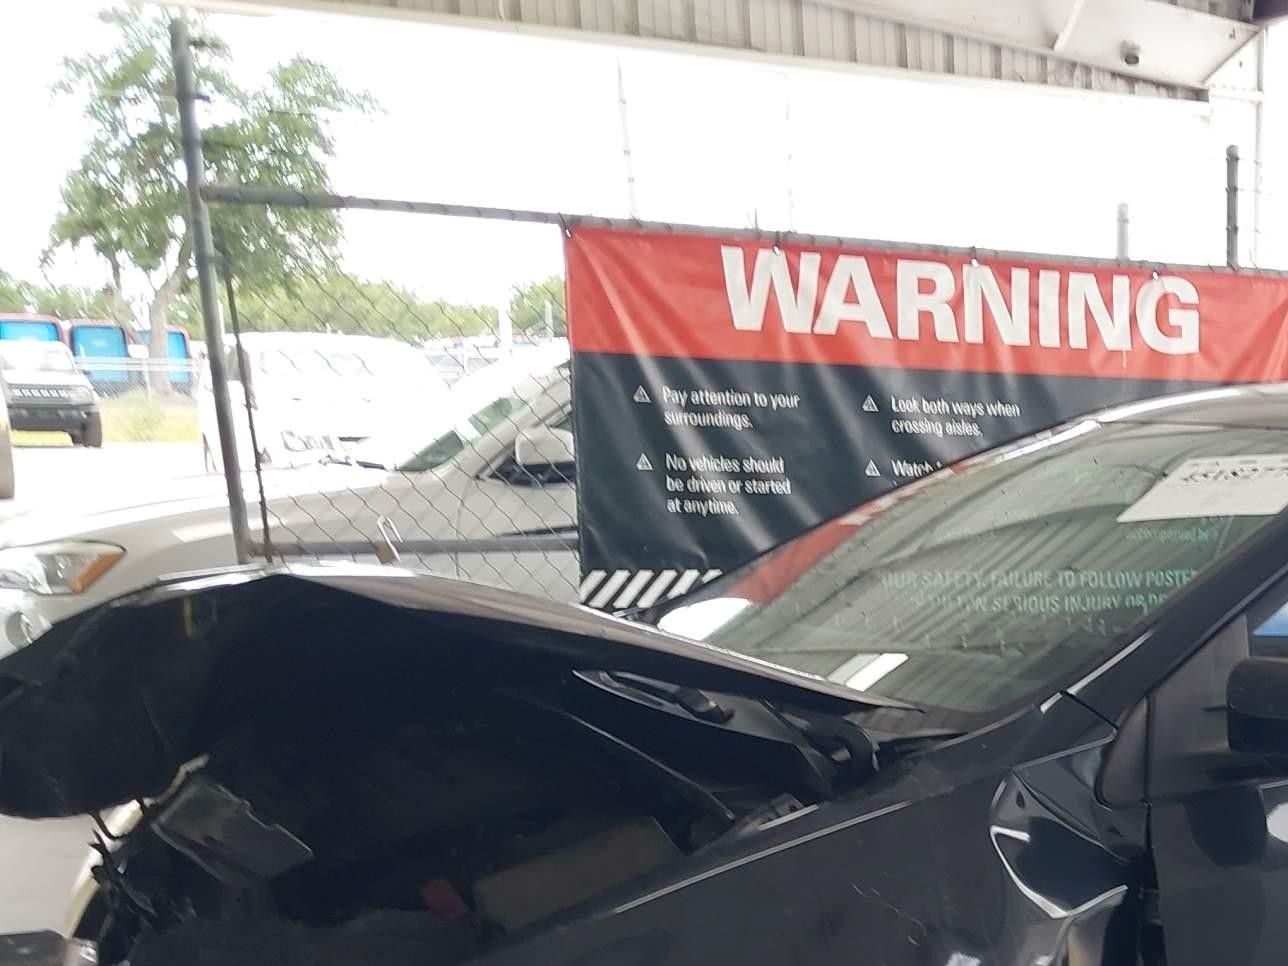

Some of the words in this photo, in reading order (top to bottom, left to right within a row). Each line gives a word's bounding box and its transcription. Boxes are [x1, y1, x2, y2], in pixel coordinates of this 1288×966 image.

[720, 245, 1200, 355] WARNING
[662, 385, 688, 407] Pay
[691, 389, 750, 407] attention
[754, 391, 767, 407] to
[770, 394, 800, 411] your
[891, 396, 920, 413] Look
[922, 397, 949, 414] both
[952, 400, 984, 418] ways
[986, 400, 1020, 417] when
[664, 410, 753, 430] surroundings.
[891, 418, 943, 437] crossing
[945, 419, 983, 436] aisles.
[665, 453, 687, 471] No
[689, 454, 740, 473] vehicles
[743, 456, 785, 473] should
[666, 476, 684, 492] be
[687, 476, 726, 494] driven
[728, 479, 742, 493] or
[745, 478, 791, 495] started
[667, 498, 681, 513] at
[684, 497, 739, 517] anytime.
[991, 570, 1053, 589] FAILURE
[1057, 569, 1075, 588] TO
[1079, 569, 1142, 589] FOLLOW
[1064, 595, 1120, 613] INJURY
